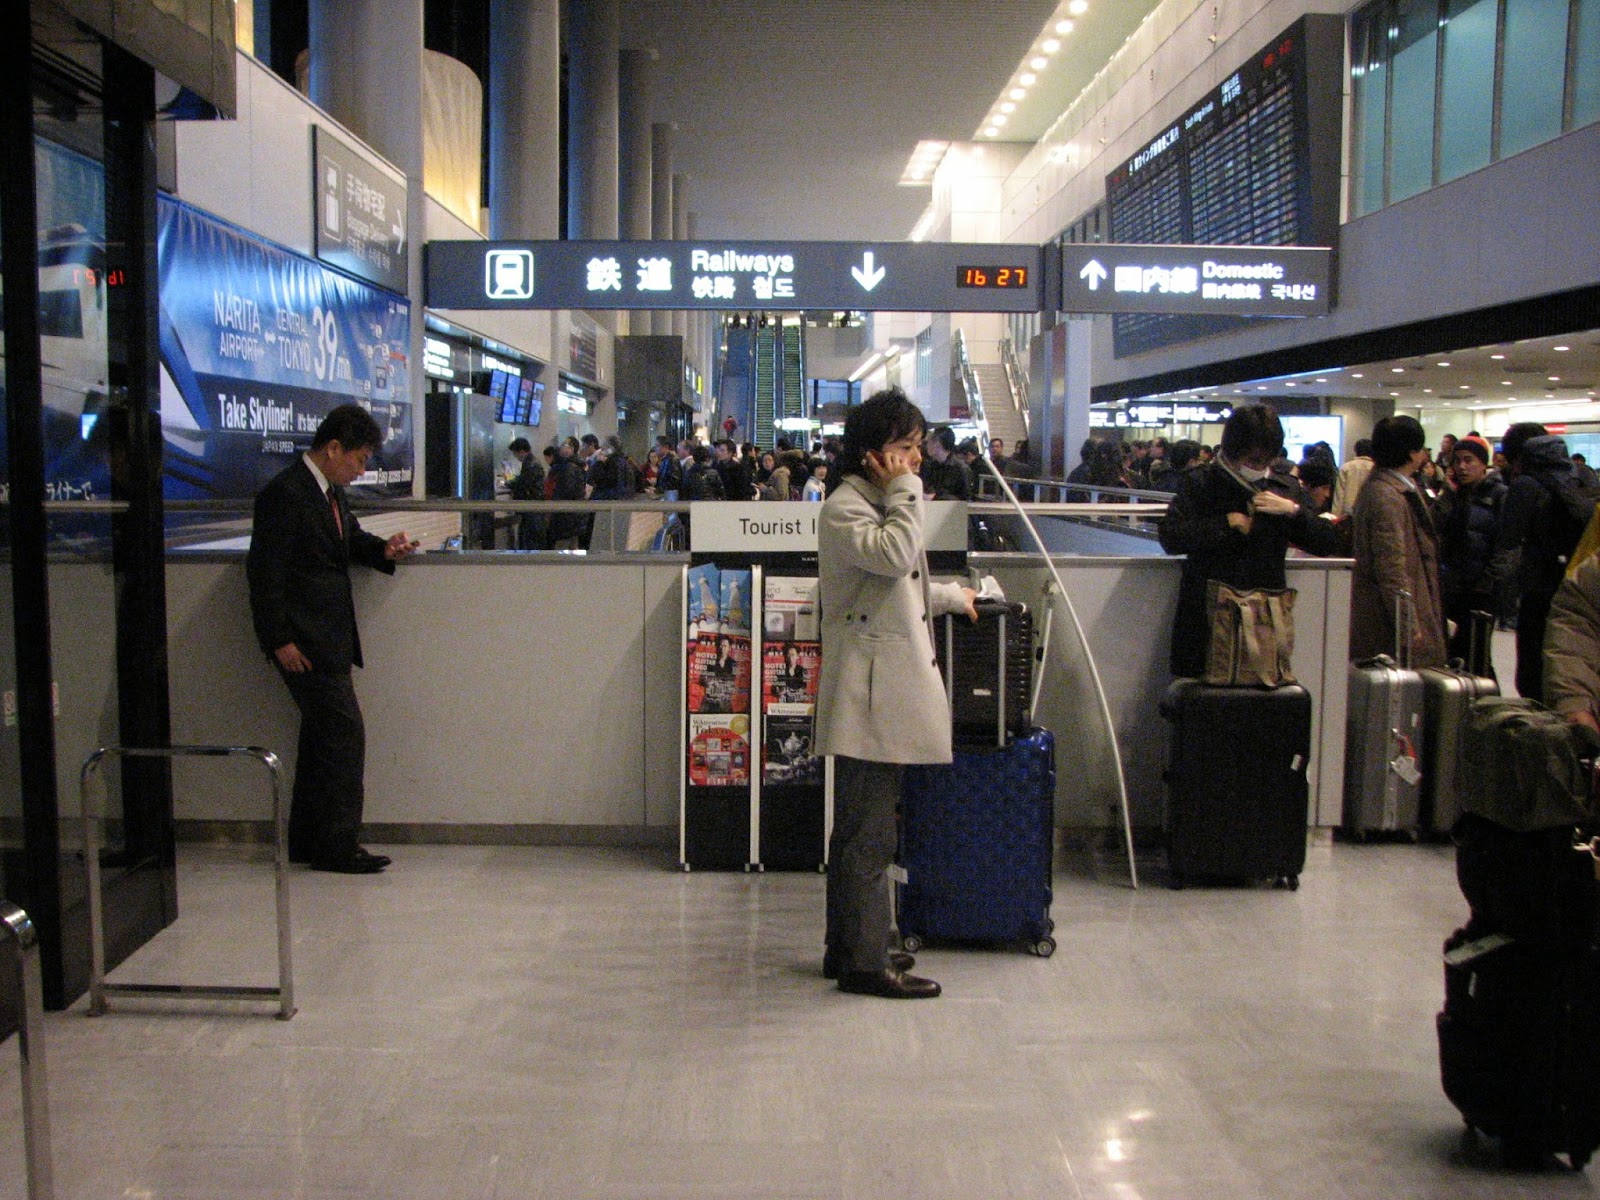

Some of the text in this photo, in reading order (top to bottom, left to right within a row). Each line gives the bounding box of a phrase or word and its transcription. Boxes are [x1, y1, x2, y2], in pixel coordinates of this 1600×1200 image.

[692, 250, 794, 277] Railways
[997, 269, 1025, 285] 27
[1202, 261, 1283, 279] Domestic
[214, 289, 261, 335] NARITA
[220, 331, 259, 361] AIRPORT
[278, 335, 311, 372] TOKYO
[312, 305, 338, 381] 39
[218, 393, 247, 429] Take
[249, 396, 293, 437] Skyliner!
[739, 518, 801, 535] Tourist
